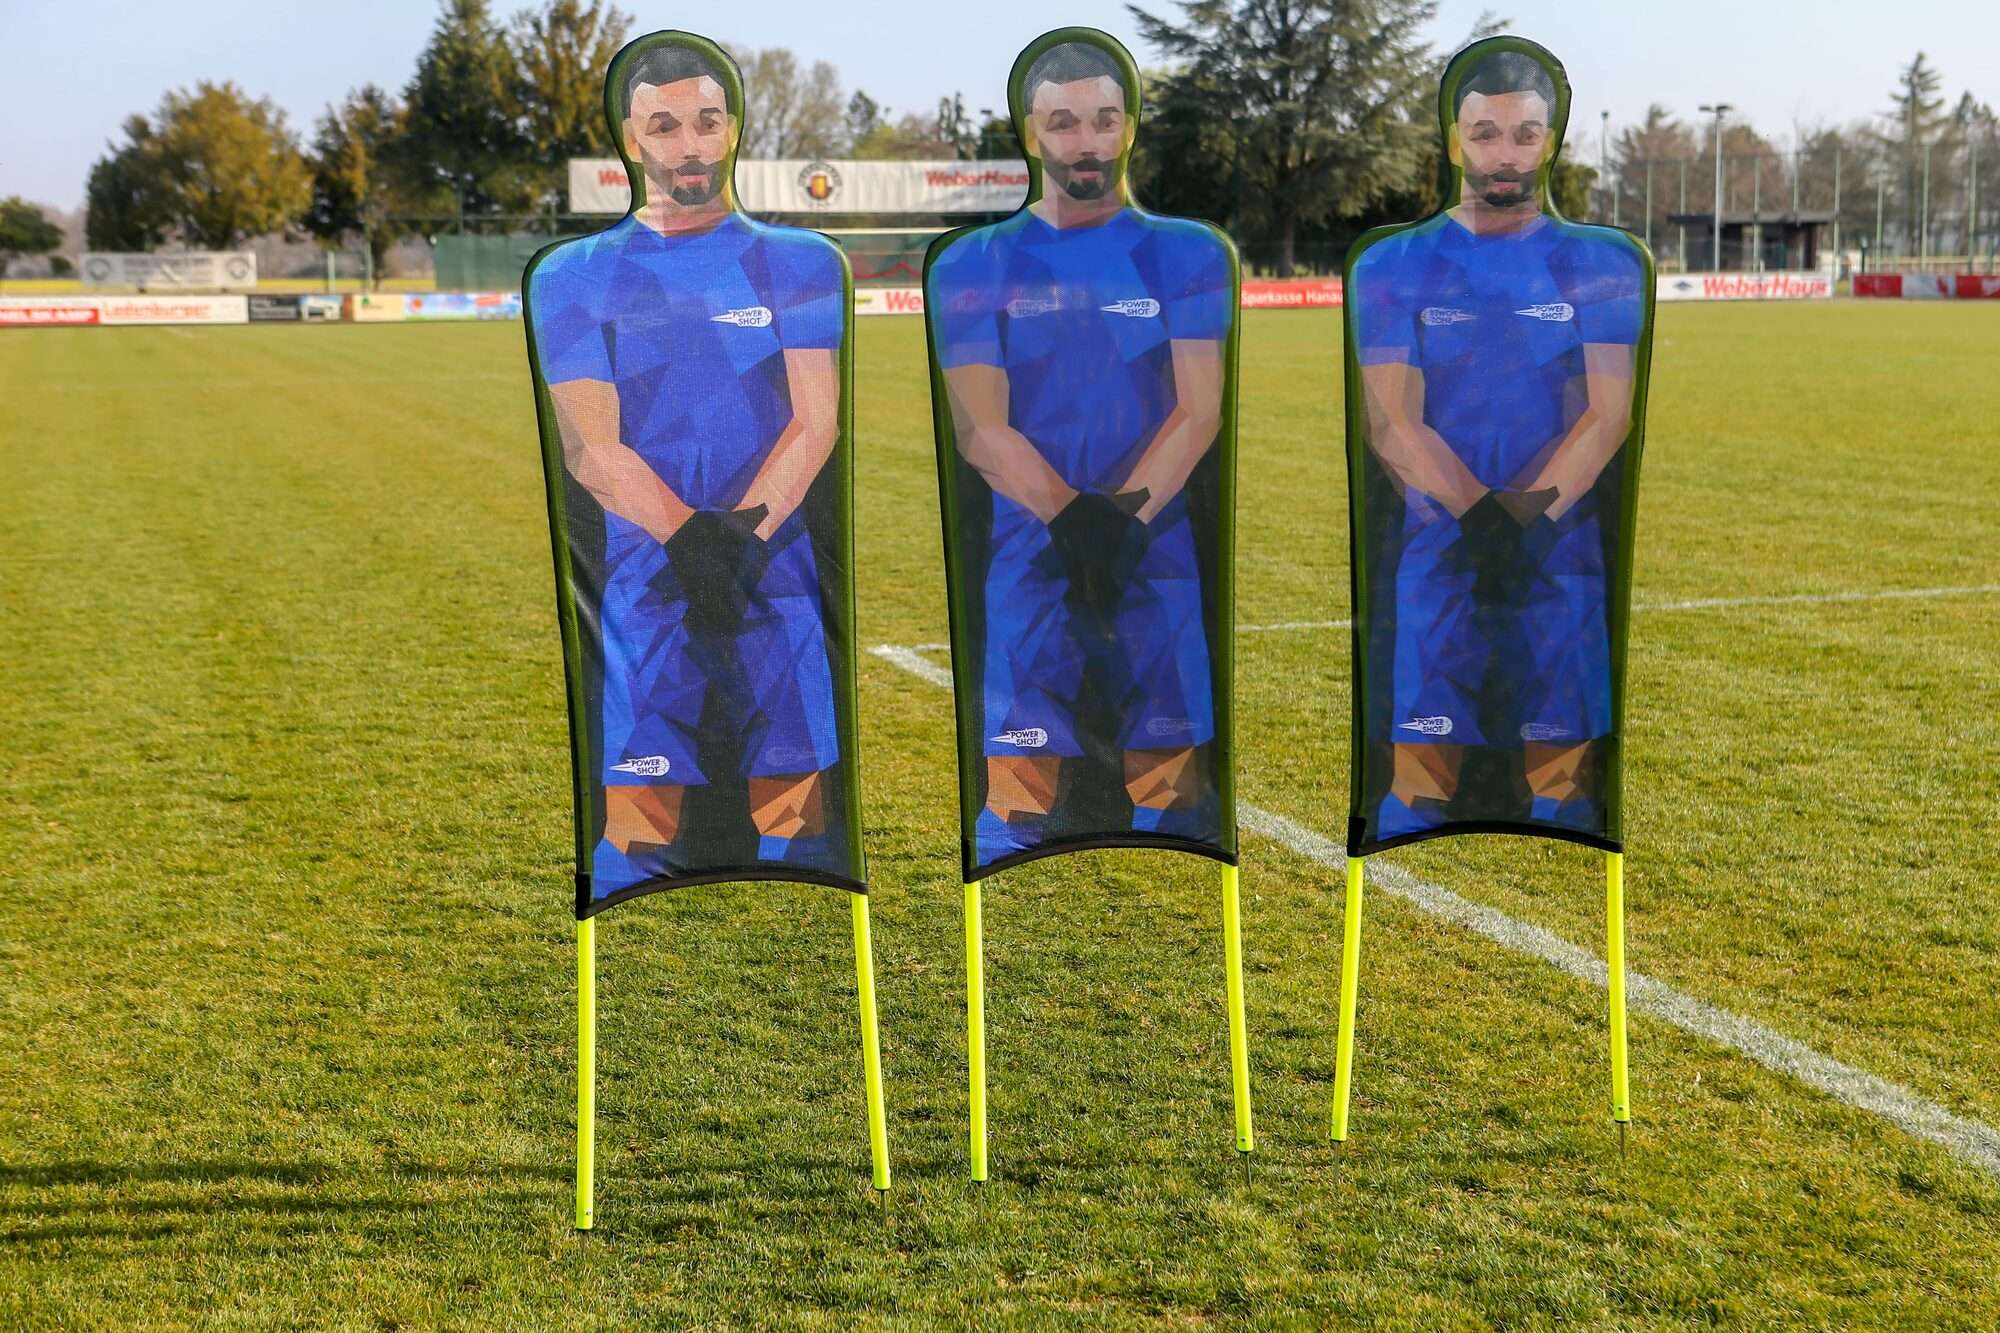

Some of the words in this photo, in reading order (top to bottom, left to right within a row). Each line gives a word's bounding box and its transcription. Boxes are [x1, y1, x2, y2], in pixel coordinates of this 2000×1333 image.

[1703, 274, 1827, 297] WeberHaus
[1121, 301, 1151, 309] POWER
[1535, 305, 1564, 313] POWER
[733, 310, 763, 318] POWER
[1126, 308, 1149, 316] SHOT
[1541, 312, 1563, 320] SHOT
[738, 317, 761, 325] SHOT
[1422, 725, 1443, 733] SHOT
[1011, 731, 1038, 739] POWER
[1016, 737, 1037, 746] SHOT
[631, 759, 660, 767] POWER
[637, 766, 659, 775] SHOT
